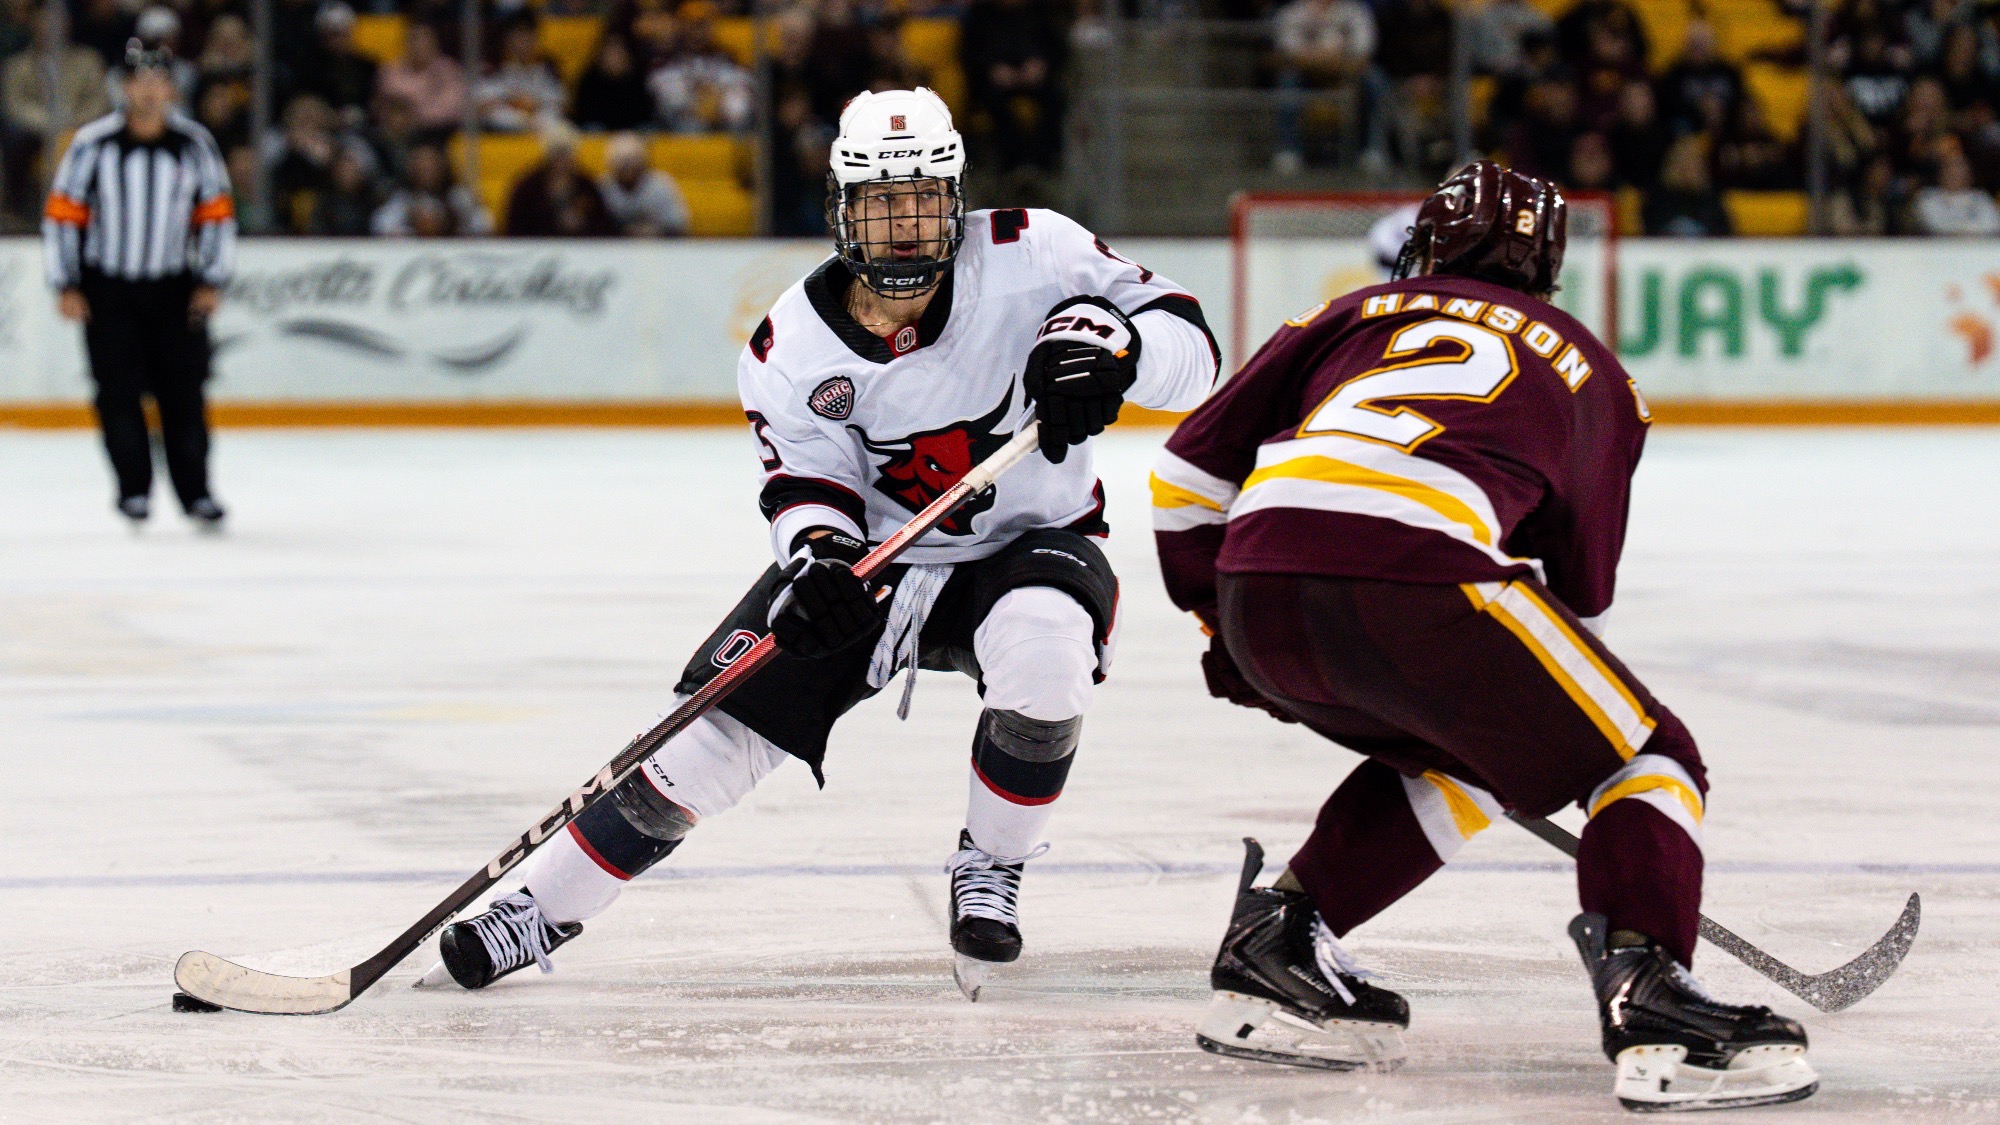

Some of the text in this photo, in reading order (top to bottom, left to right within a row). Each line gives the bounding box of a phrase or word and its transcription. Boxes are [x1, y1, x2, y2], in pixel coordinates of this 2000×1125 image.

[877, 149, 923, 159] CCM
[1515, 208, 1536, 237] 2
[882, 275, 925, 286] CCM
[1362, 292, 1593, 393] HANSON
[814, 383, 850, 409] NCHC
[1295, 316, 1520, 455] 2
[831, 534, 863, 548] CCM
[1031, 548, 1088, 567] CCM
[487, 762, 614, 879] CCM
